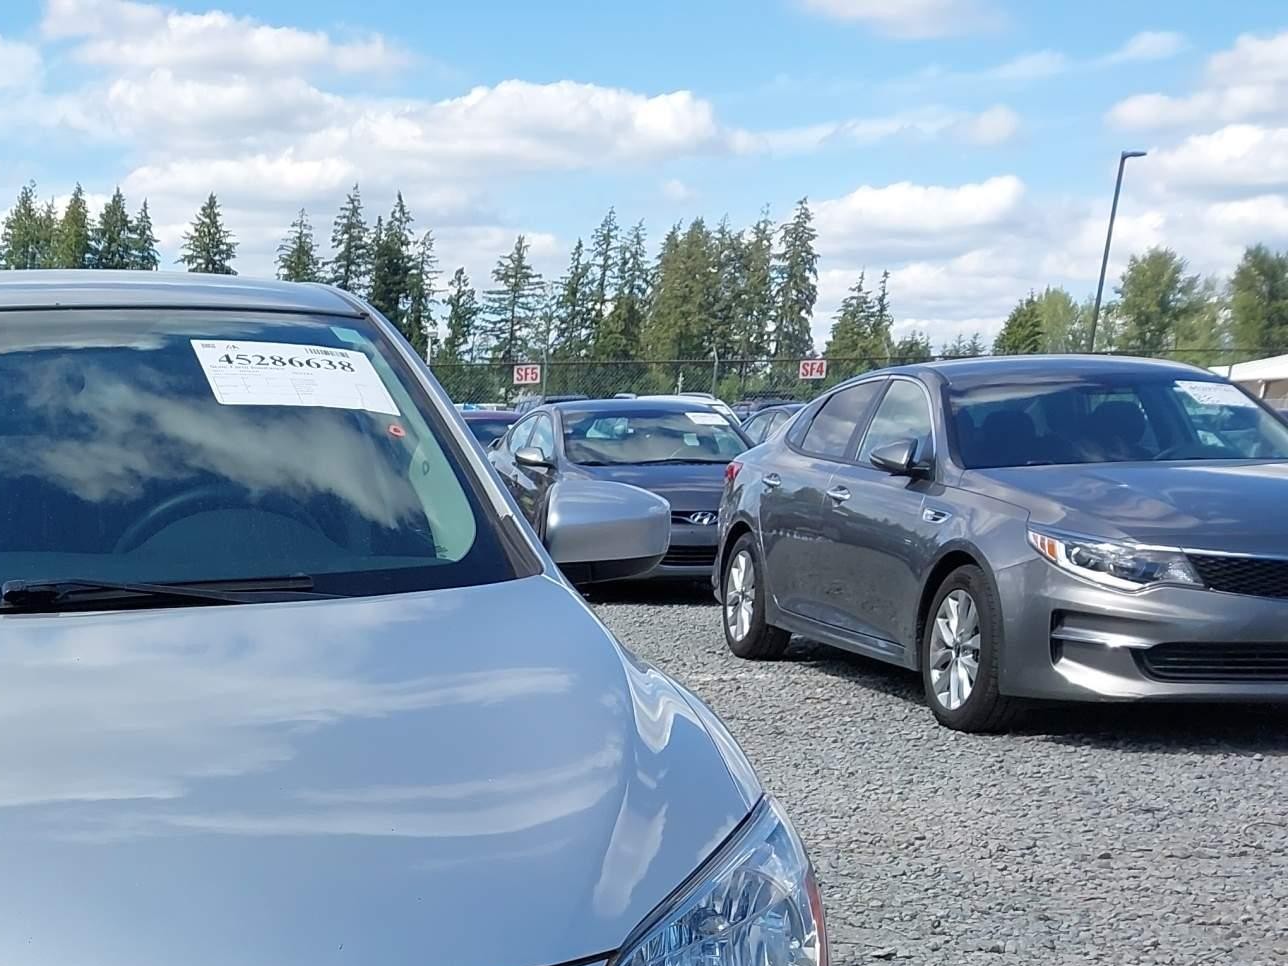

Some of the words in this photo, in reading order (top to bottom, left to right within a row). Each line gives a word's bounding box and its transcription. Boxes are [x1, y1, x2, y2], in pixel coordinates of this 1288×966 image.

[218, 353, 356, 373] 45286638
[802, 362, 824, 377] SF4
[516, 367, 538, 382] SF5
